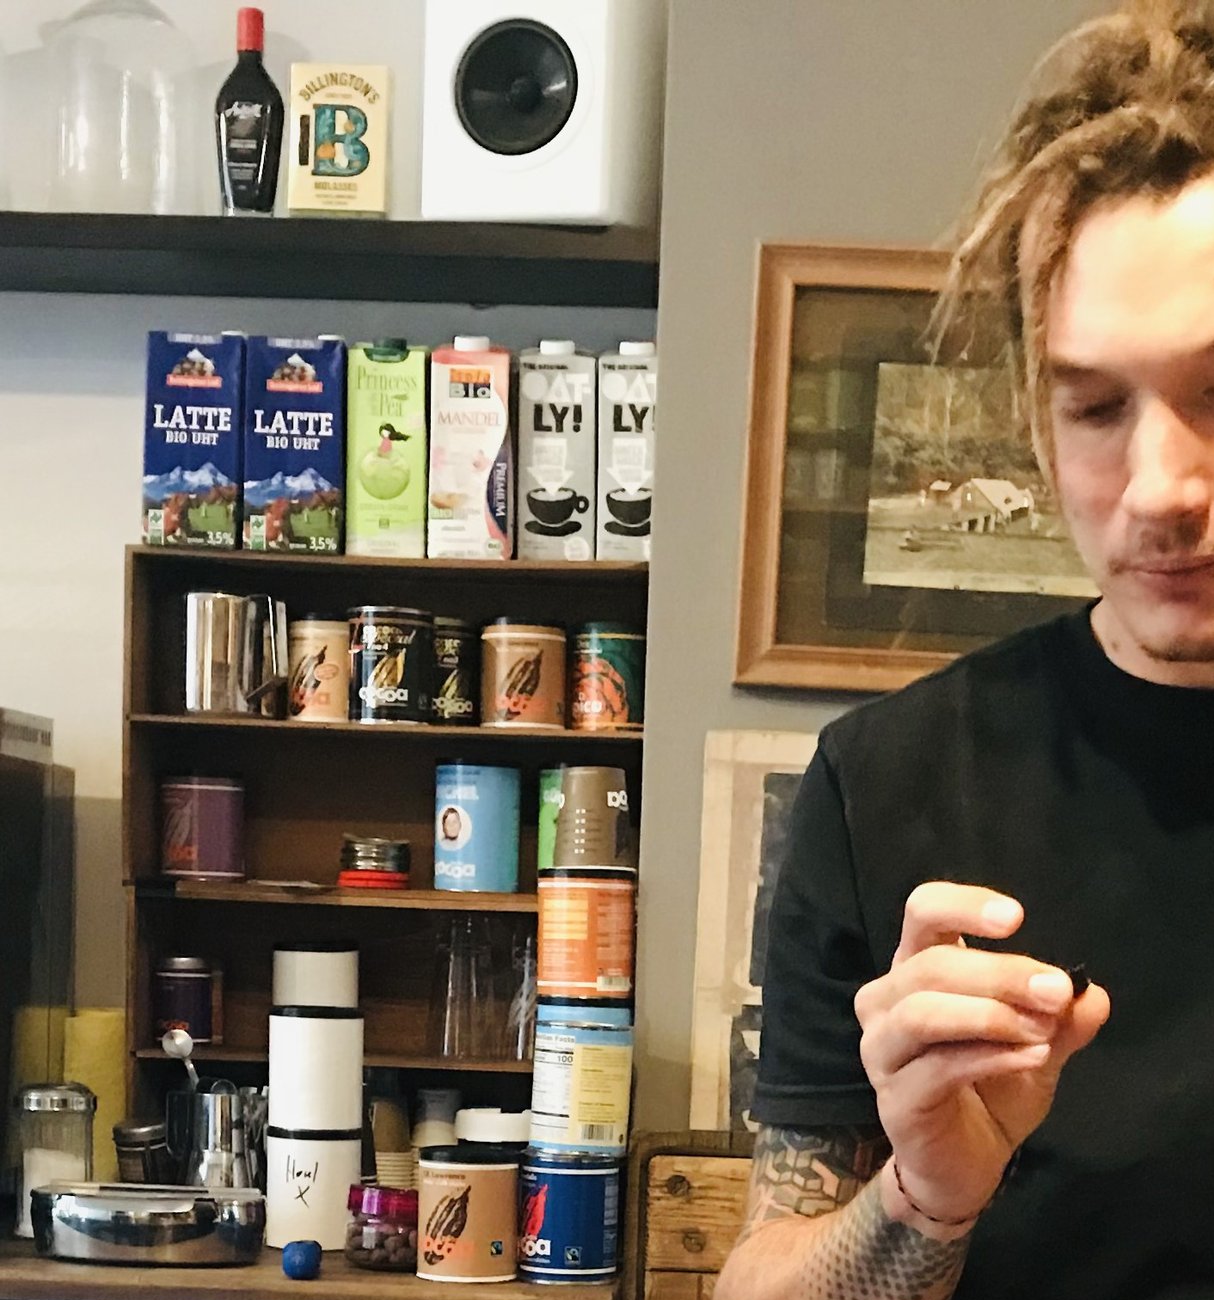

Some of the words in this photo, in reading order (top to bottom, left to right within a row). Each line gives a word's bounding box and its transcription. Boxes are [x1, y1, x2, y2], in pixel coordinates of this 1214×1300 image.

[299, 72, 381, 104] BILLINGTON'S
[154, 404, 232, 432] LATTE
[254, 410, 333, 436] LATTE
[438, 411, 501, 426] MANDEL
[533, 403, 583, 433] LY!
[166, 430, 187, 444] BIO
[192, 432, 219, 446] UHT
[266, 436, 288, 449] BIO
[293, 437, 320, 451] UHT
[495, 462, 507, 518] PREMIUM
[207, 531, 234, 546] 3,5%
[309, 537, 337, 551] 3,5%
